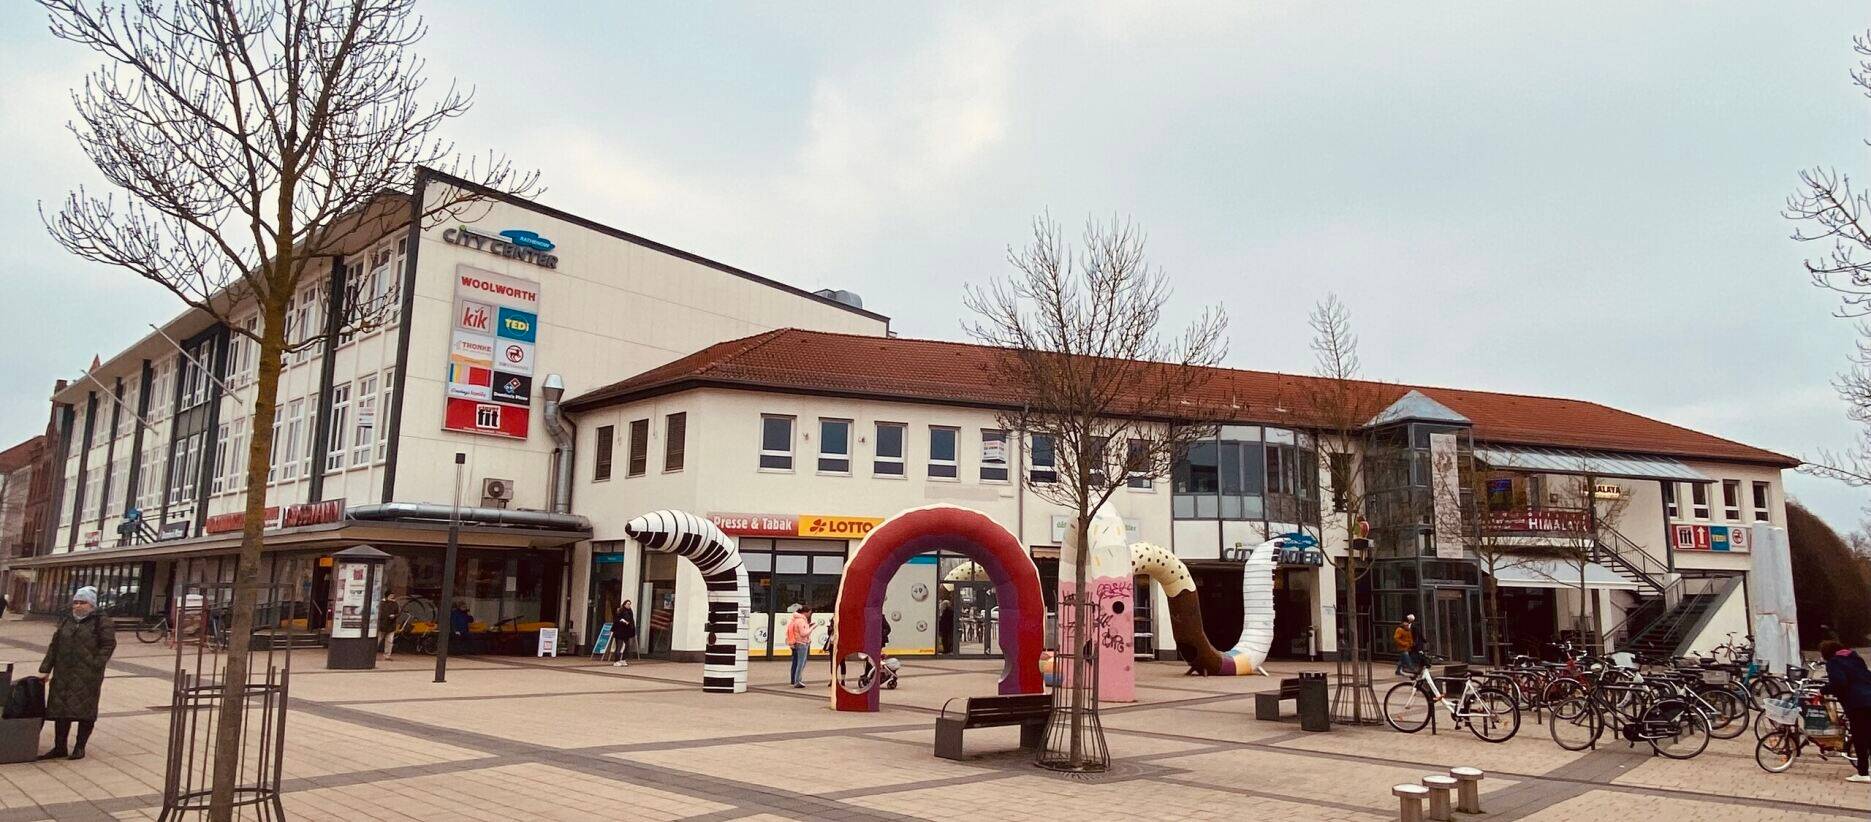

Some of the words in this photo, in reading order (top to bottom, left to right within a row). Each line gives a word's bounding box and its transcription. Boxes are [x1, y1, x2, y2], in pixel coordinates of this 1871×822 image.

[442, 225, 486, 251] CITY
[489, 239, 559, 269] CENTER
[461, 276, 536, 302] WOOLWORTH
[478, 409, 499, 427] fit
[713, 516, 748, 530] Presse
[751, 517, 760, 530] &
[763, 517, 792, 531] Tabak
[829, 520, 874, 534] LOTTO
